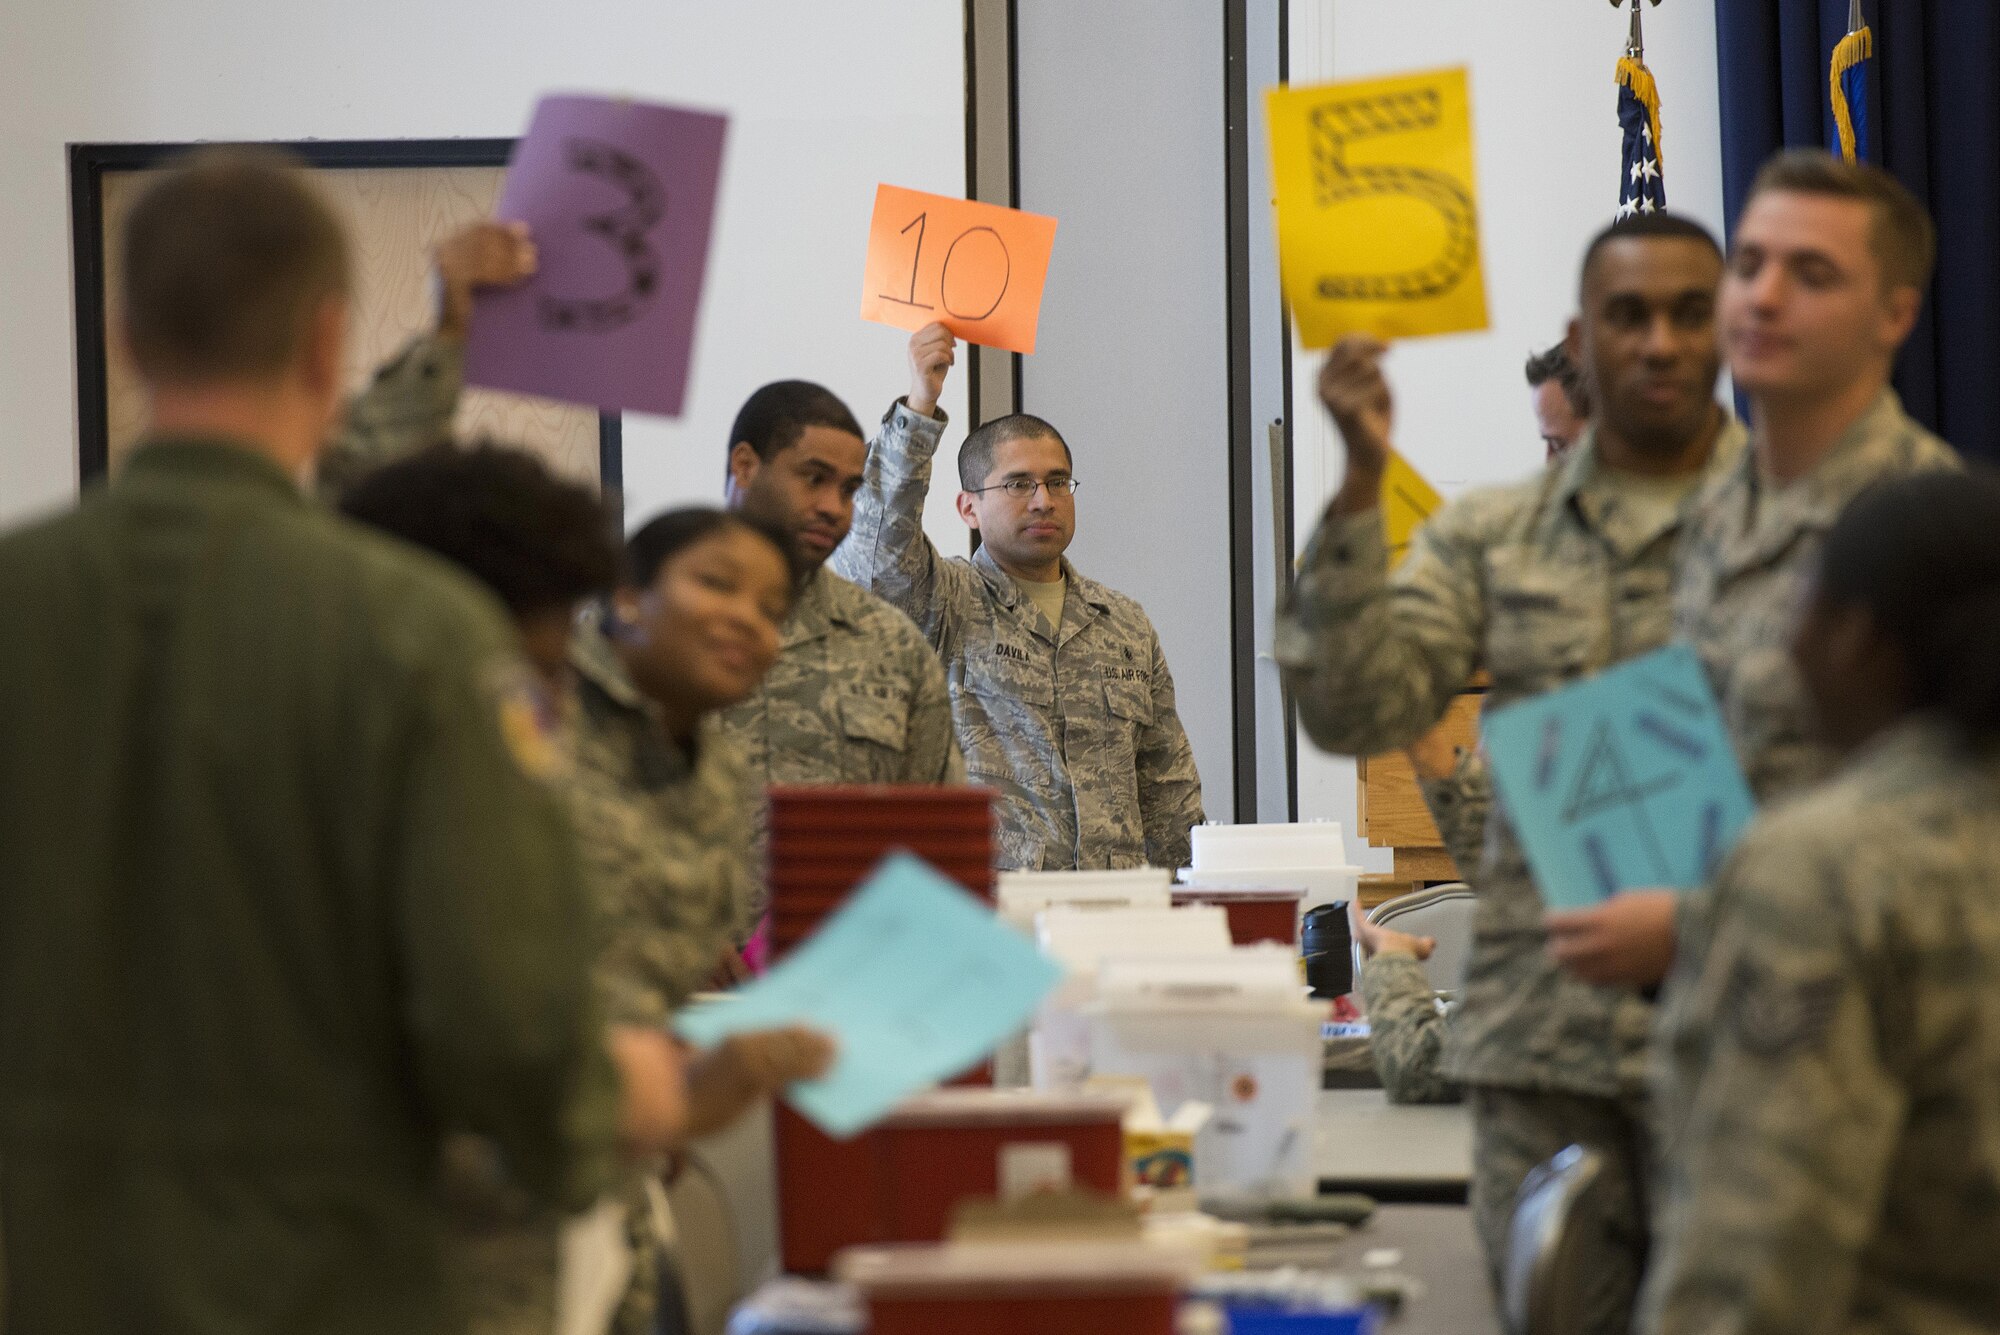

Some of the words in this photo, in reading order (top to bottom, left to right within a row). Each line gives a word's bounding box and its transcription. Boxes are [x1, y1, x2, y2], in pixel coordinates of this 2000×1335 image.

[535, 134, 668, 336] 3
[1307, 85, 1478, 302] 5
[878, 211, 1010, 321] 10
[995, 643, 1030, 661] DAVILA
[1121, 668, 1136, 681] AIR
[1559, 716, 1683, 880] 4
